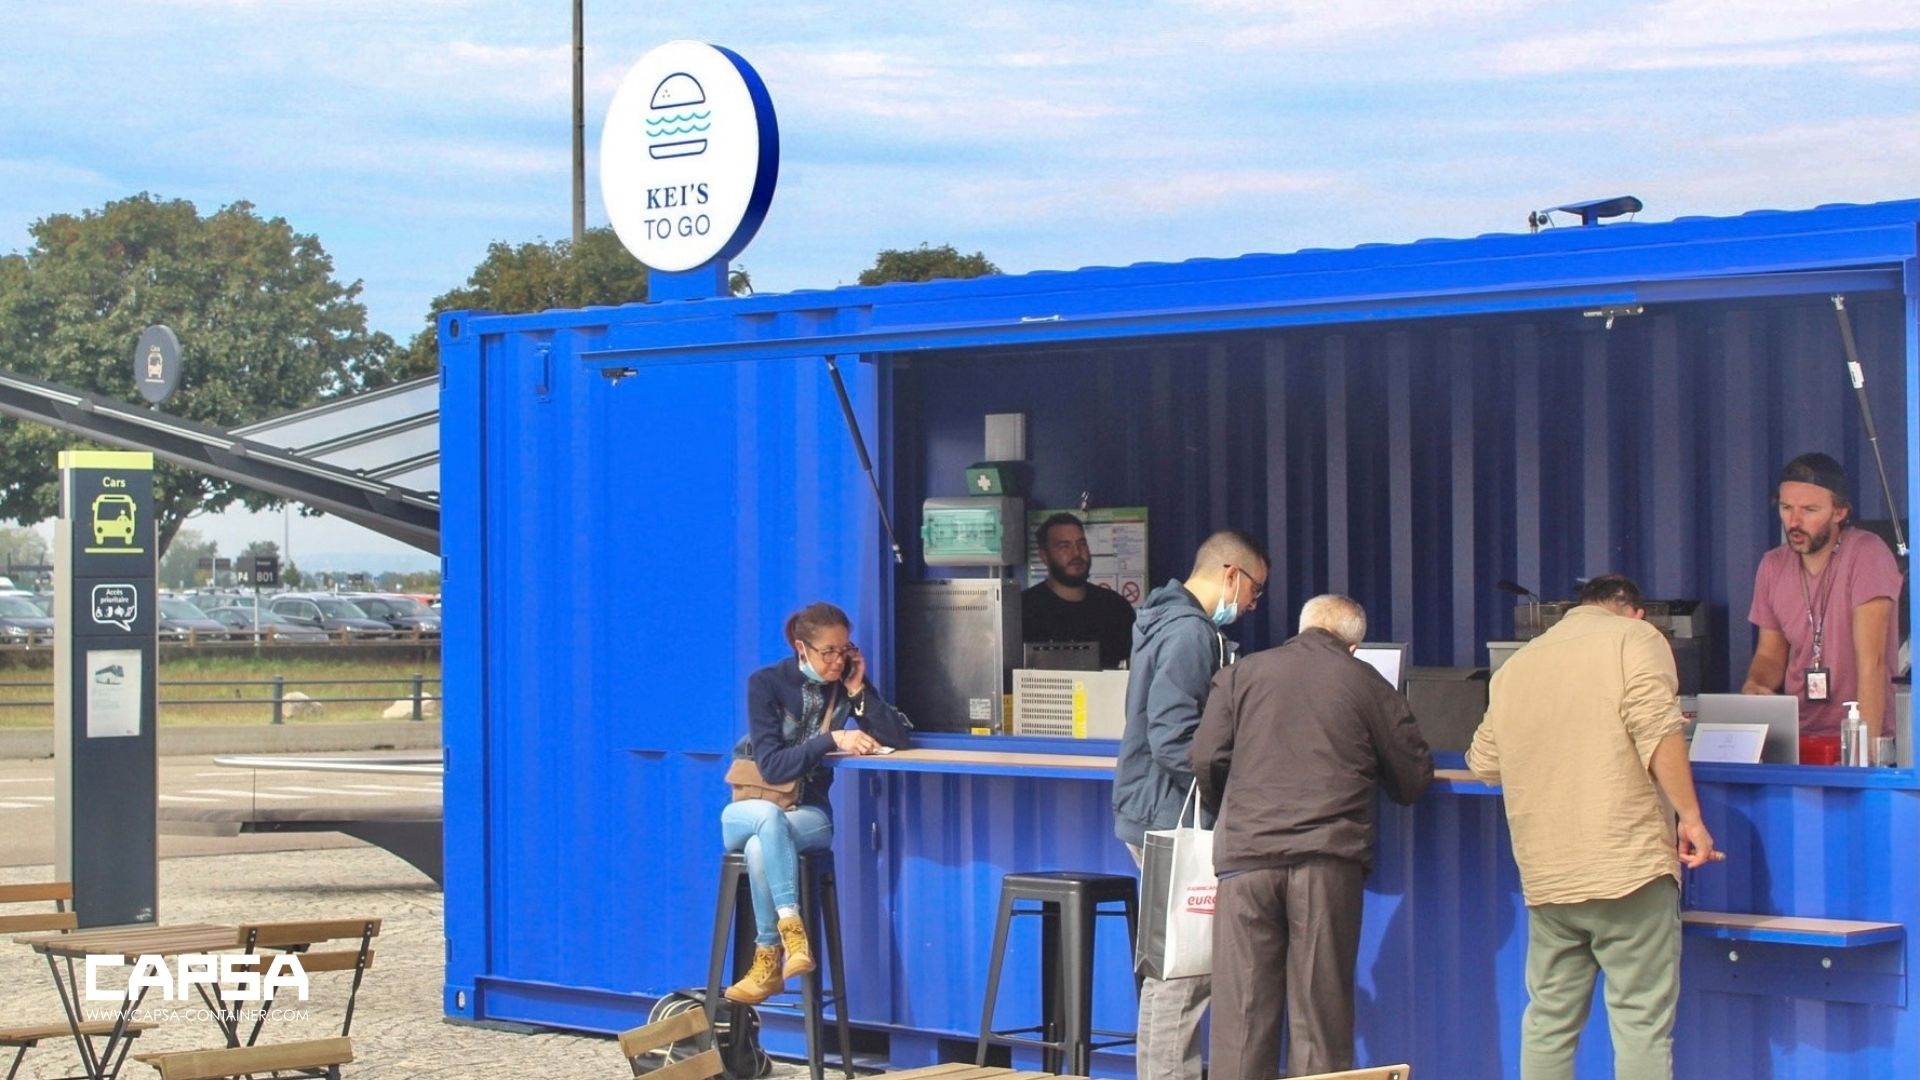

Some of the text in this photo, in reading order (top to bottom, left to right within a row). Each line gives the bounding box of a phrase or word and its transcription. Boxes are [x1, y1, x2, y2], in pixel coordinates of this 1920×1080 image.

[646, 182, 709, 210] KEI'S
[643, 213, 711, 240] TO GO
[102, 476, 126, 488] Cars
[238, 571, 249, 582] P4
